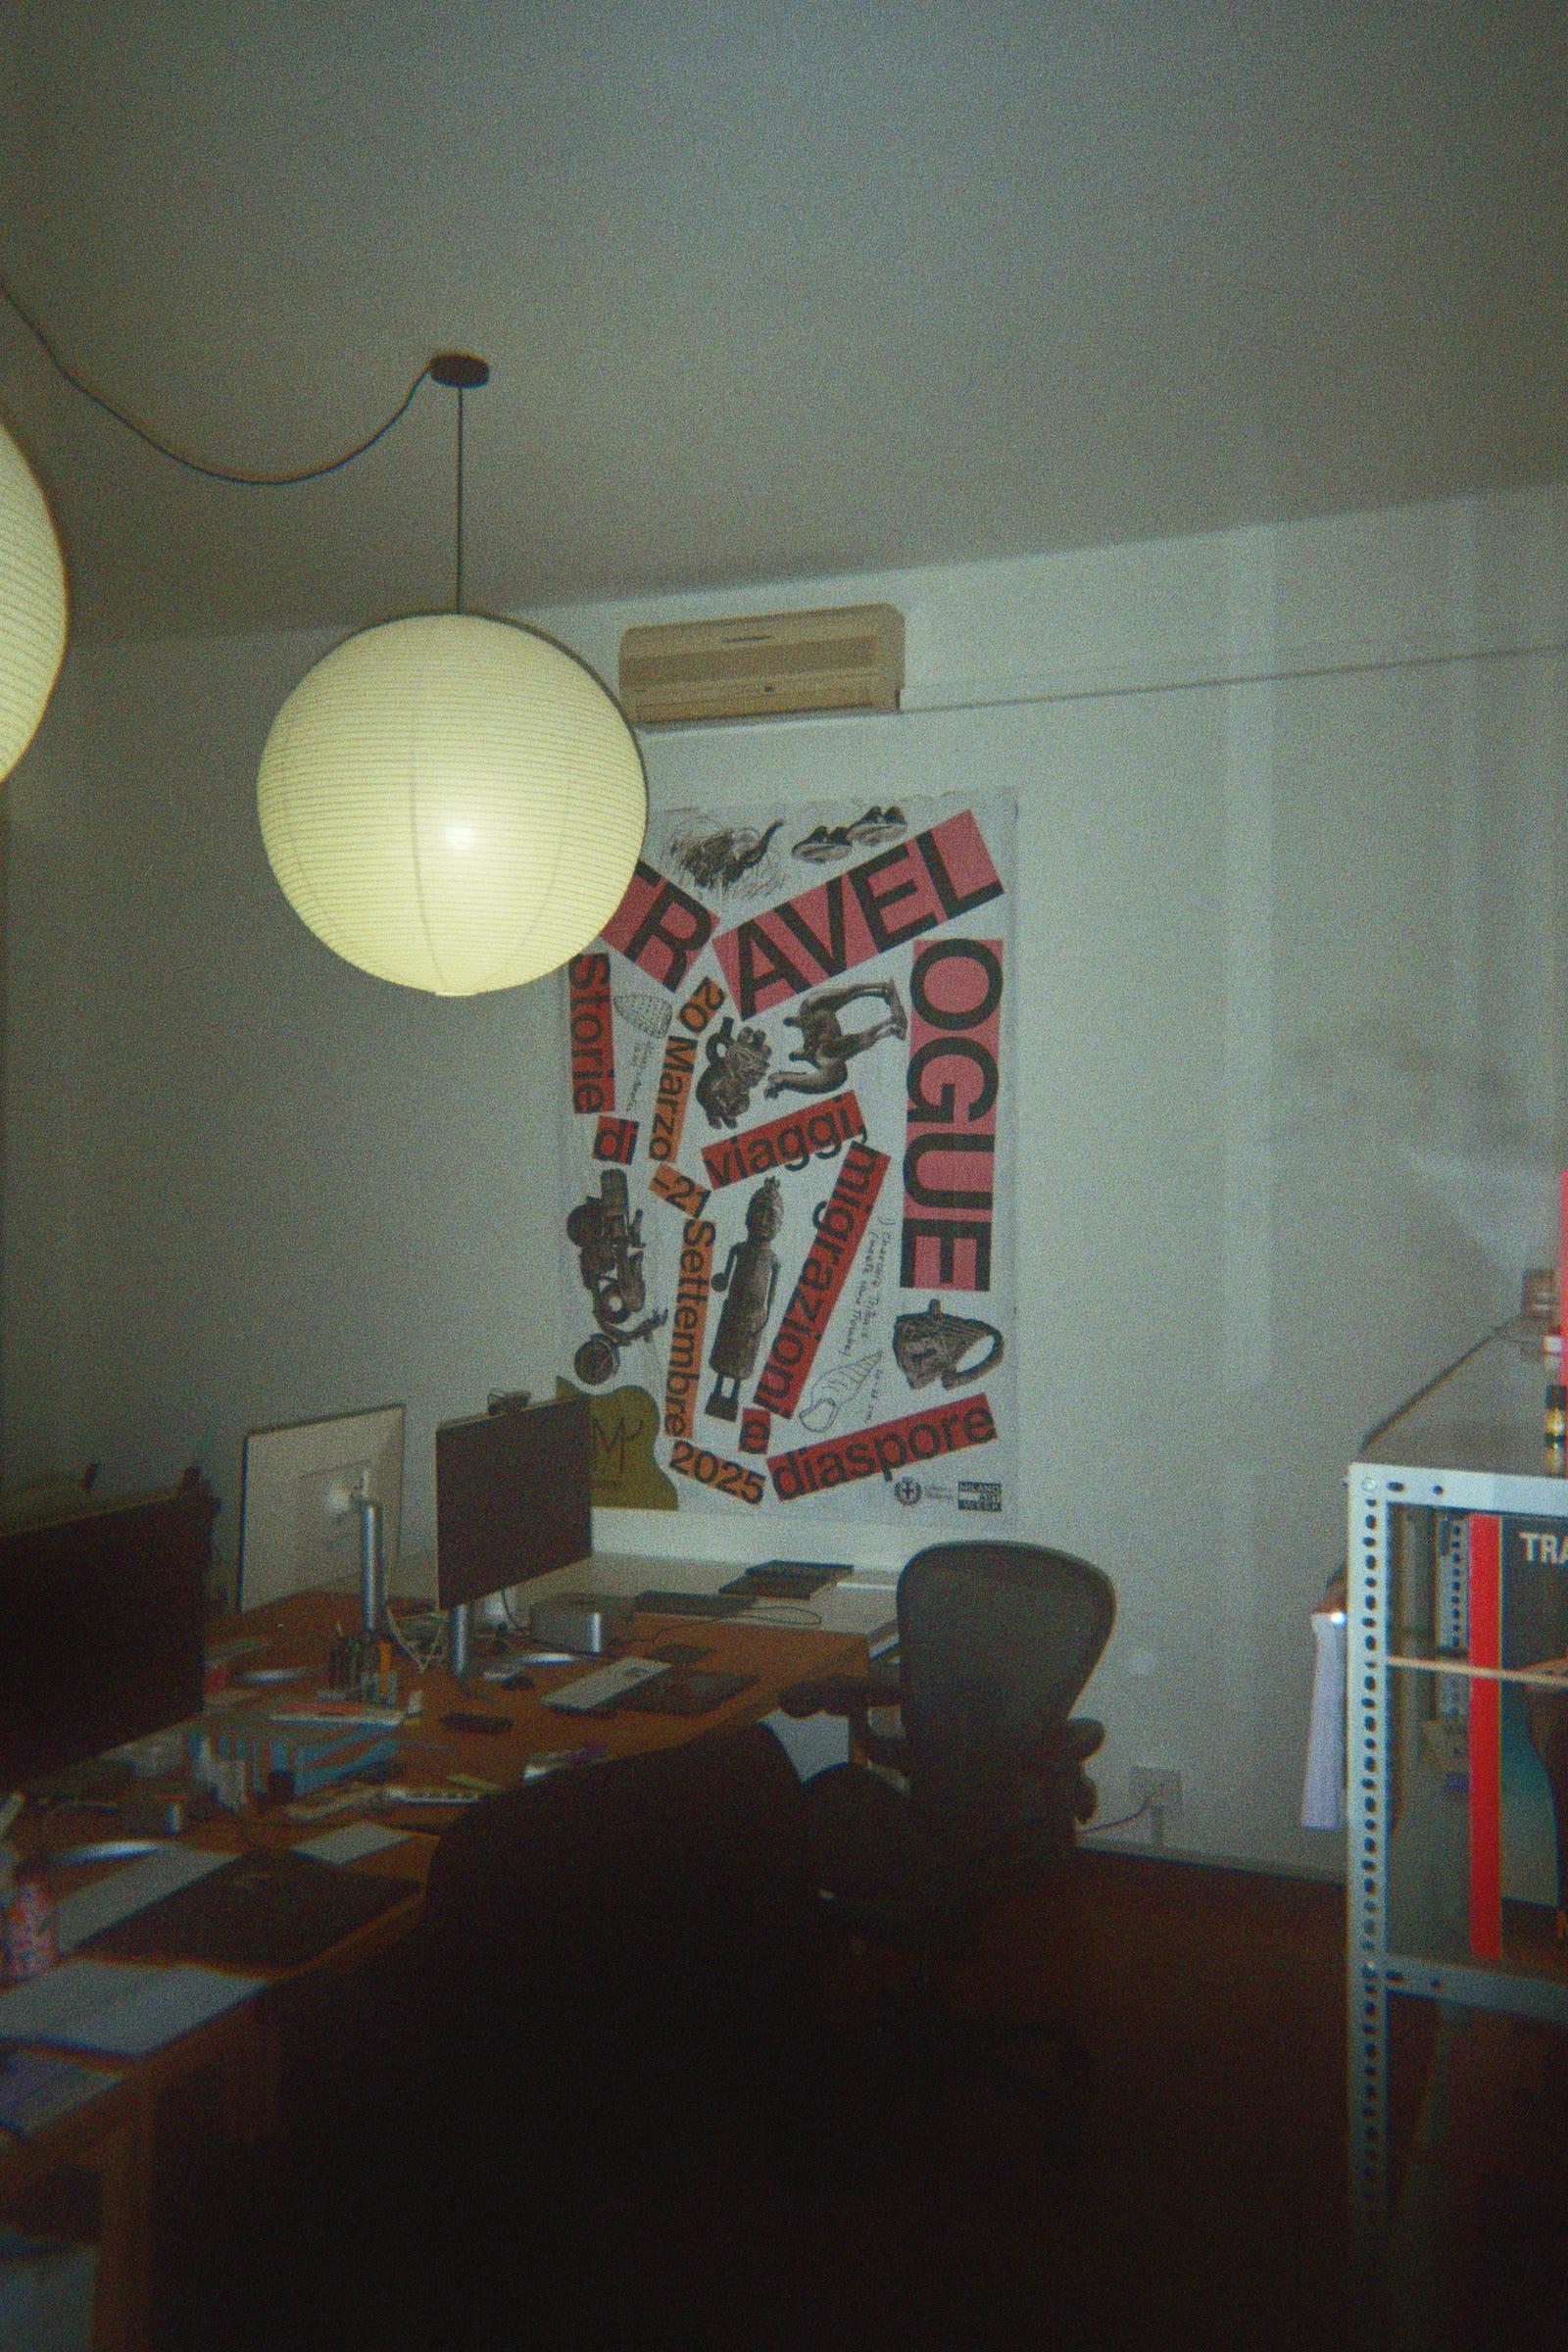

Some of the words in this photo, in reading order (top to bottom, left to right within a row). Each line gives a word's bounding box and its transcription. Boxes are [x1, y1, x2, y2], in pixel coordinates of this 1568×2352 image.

[568, 953, 614, 1114] Storie
[679, 977, 725, 1034] 20
[594, 1118, 639, 1165] di
[649, 1036, 698, 1161] Marzo
[754, 1141, 880, 1419] migrazioni
[665, 1218, 716, 1437] Settembre
[669, 1440, 766, 1504] 2025
[739, 1423, 770, 1455] e
[770, 1406, 997, 1500] diaspore
